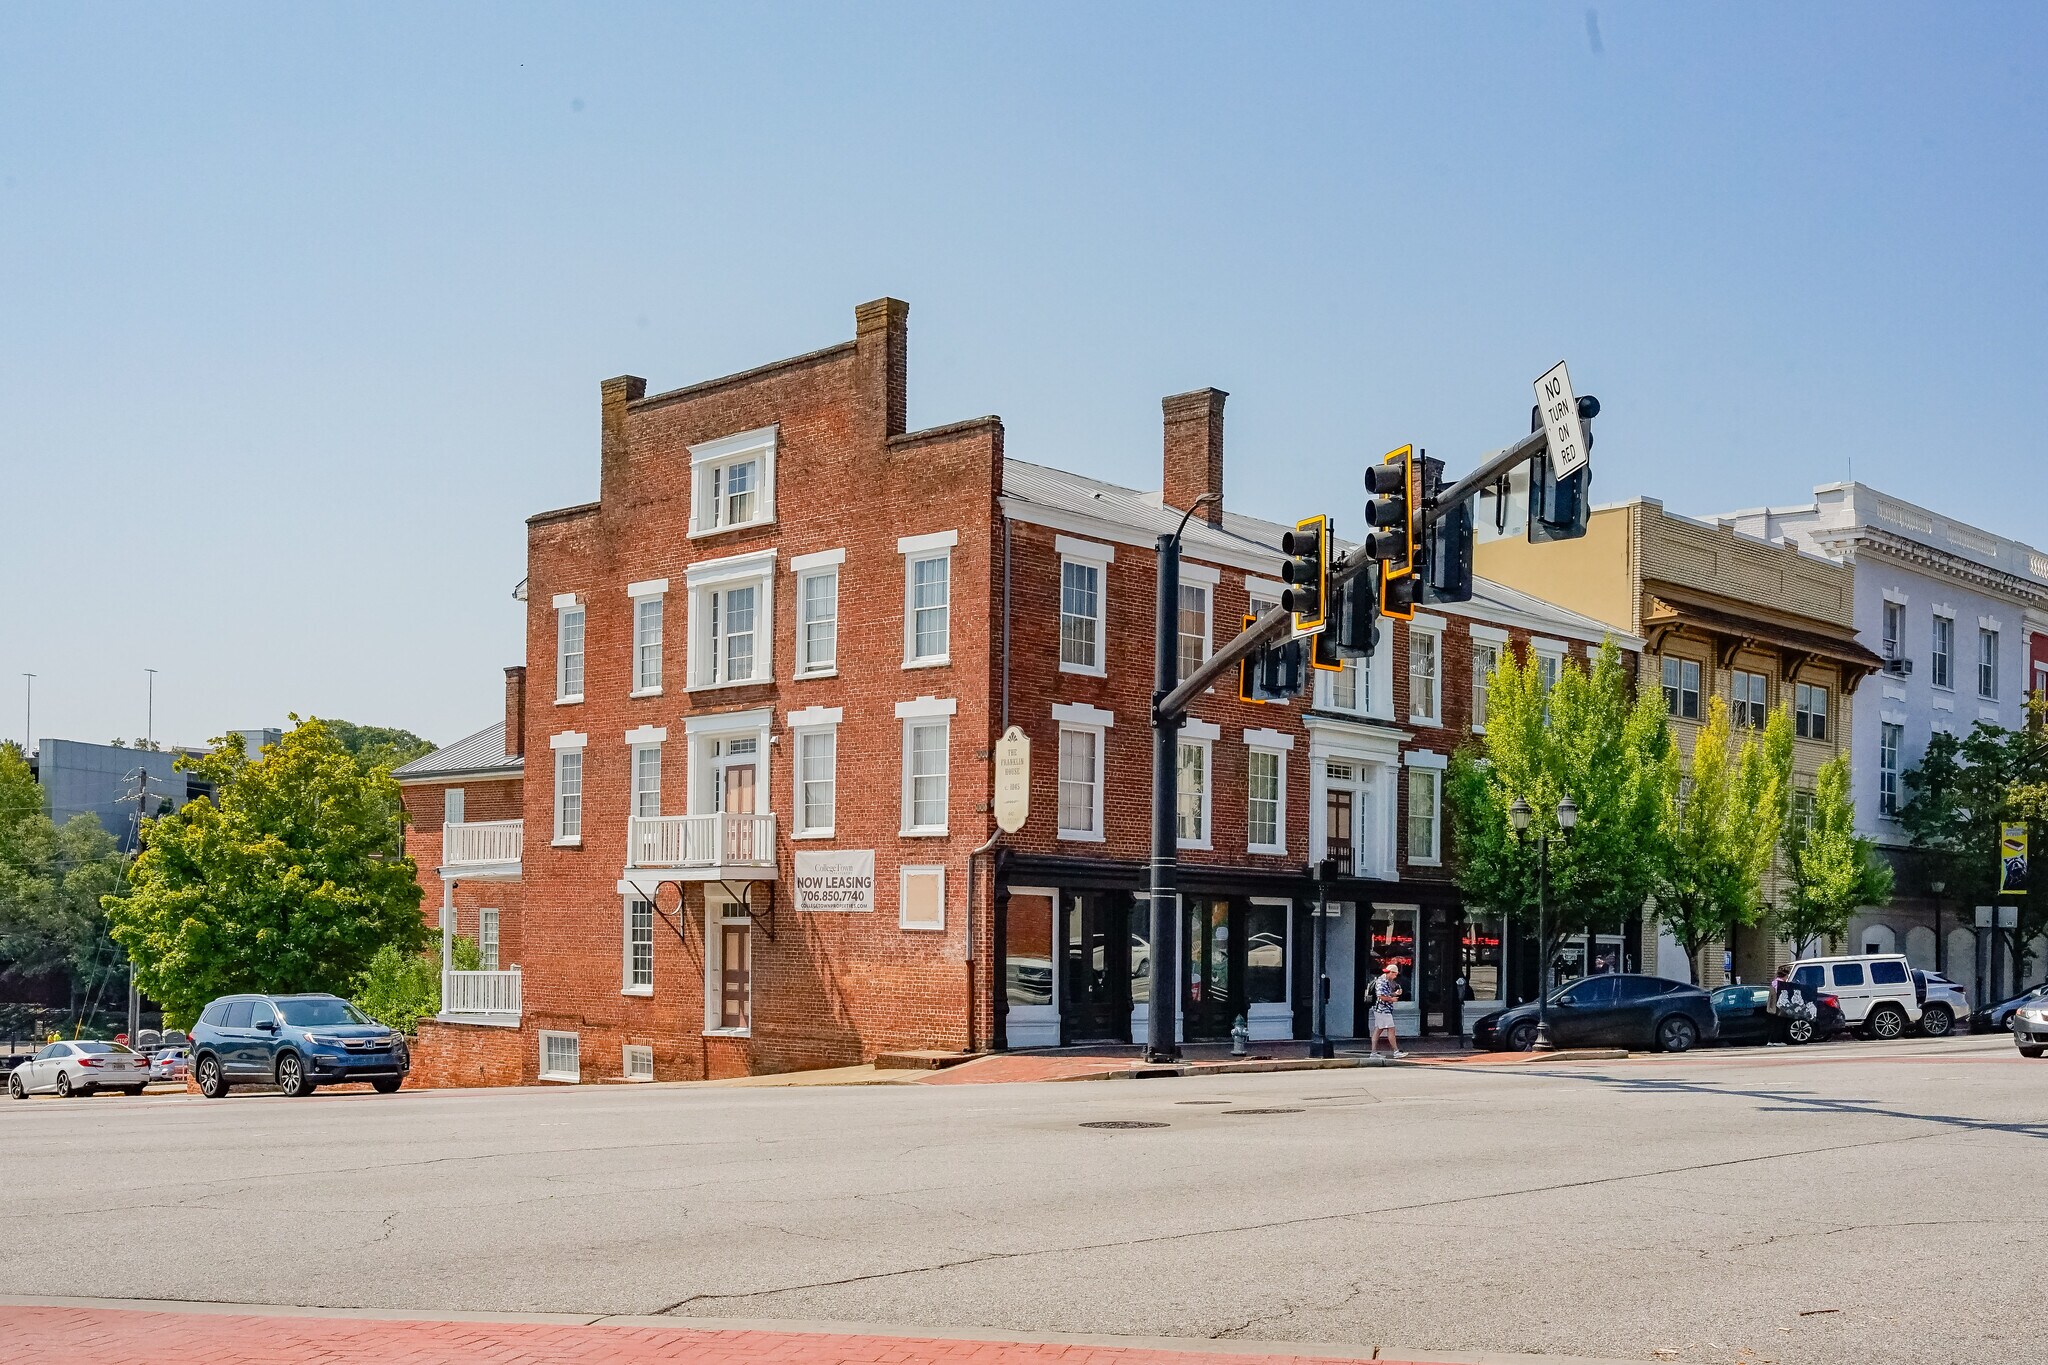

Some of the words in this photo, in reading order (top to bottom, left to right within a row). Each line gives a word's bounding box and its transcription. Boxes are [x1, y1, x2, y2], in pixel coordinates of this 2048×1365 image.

[1545, 377, 1560, 401] NO
[1548, 399, 1569, 423] TURN
[1558, 423, 1570, 442] ON
[1561, 444, 1576, 466] RED
[1001, 758, 1024, 766] FRANKLIN
[797, 877, 823, 888] NOW
[826, 876, 872, 888] LEASING
[803, 890, 865, 901] 706.850.7740
